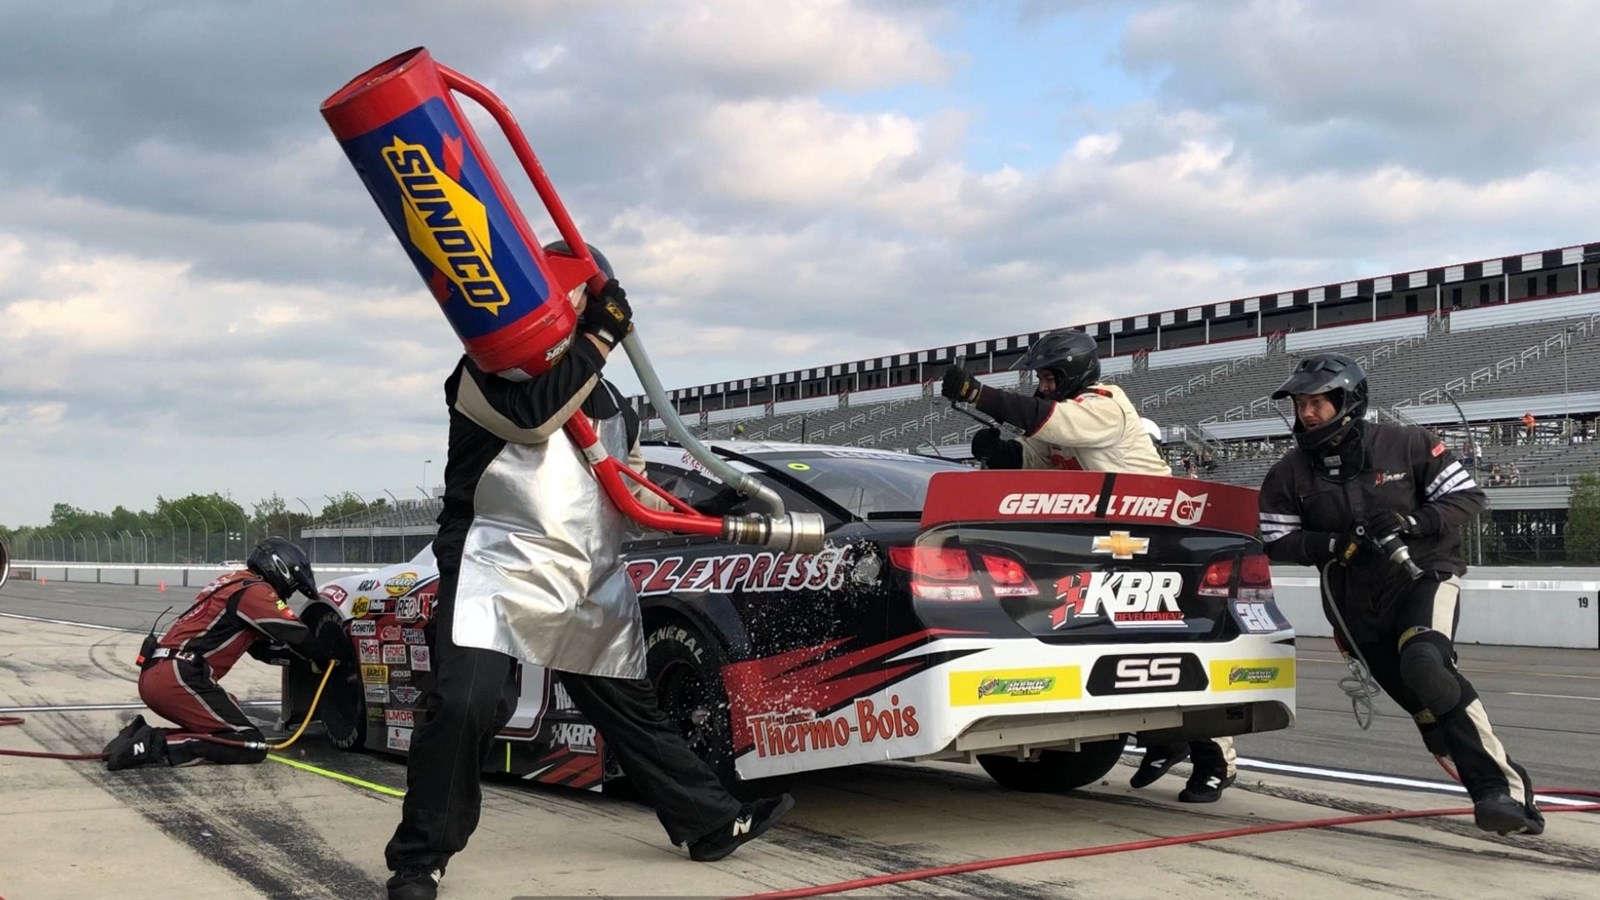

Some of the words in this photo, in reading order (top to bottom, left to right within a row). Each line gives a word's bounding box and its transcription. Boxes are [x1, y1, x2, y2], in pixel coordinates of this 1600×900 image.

[385, 148, 506, 305] SUNOCO
[998, 493, 1117, 516] GENERAL
[1120, 494, 1173, 518] TIRE
[675, 545, 853, 593] EXPRESS!
[1080, 571, 1184, 616] KBR
[1578, 596, 1589, 609] 19
[1114, 611, 1184, 623] DEVELOPMENT
[1235, 602, 1277, 632] 28
[1114, 657, 1182, 689] SS
[560, 723, 597, 746] KBR
[748, 694, 920, 758] Thermo-Bois
